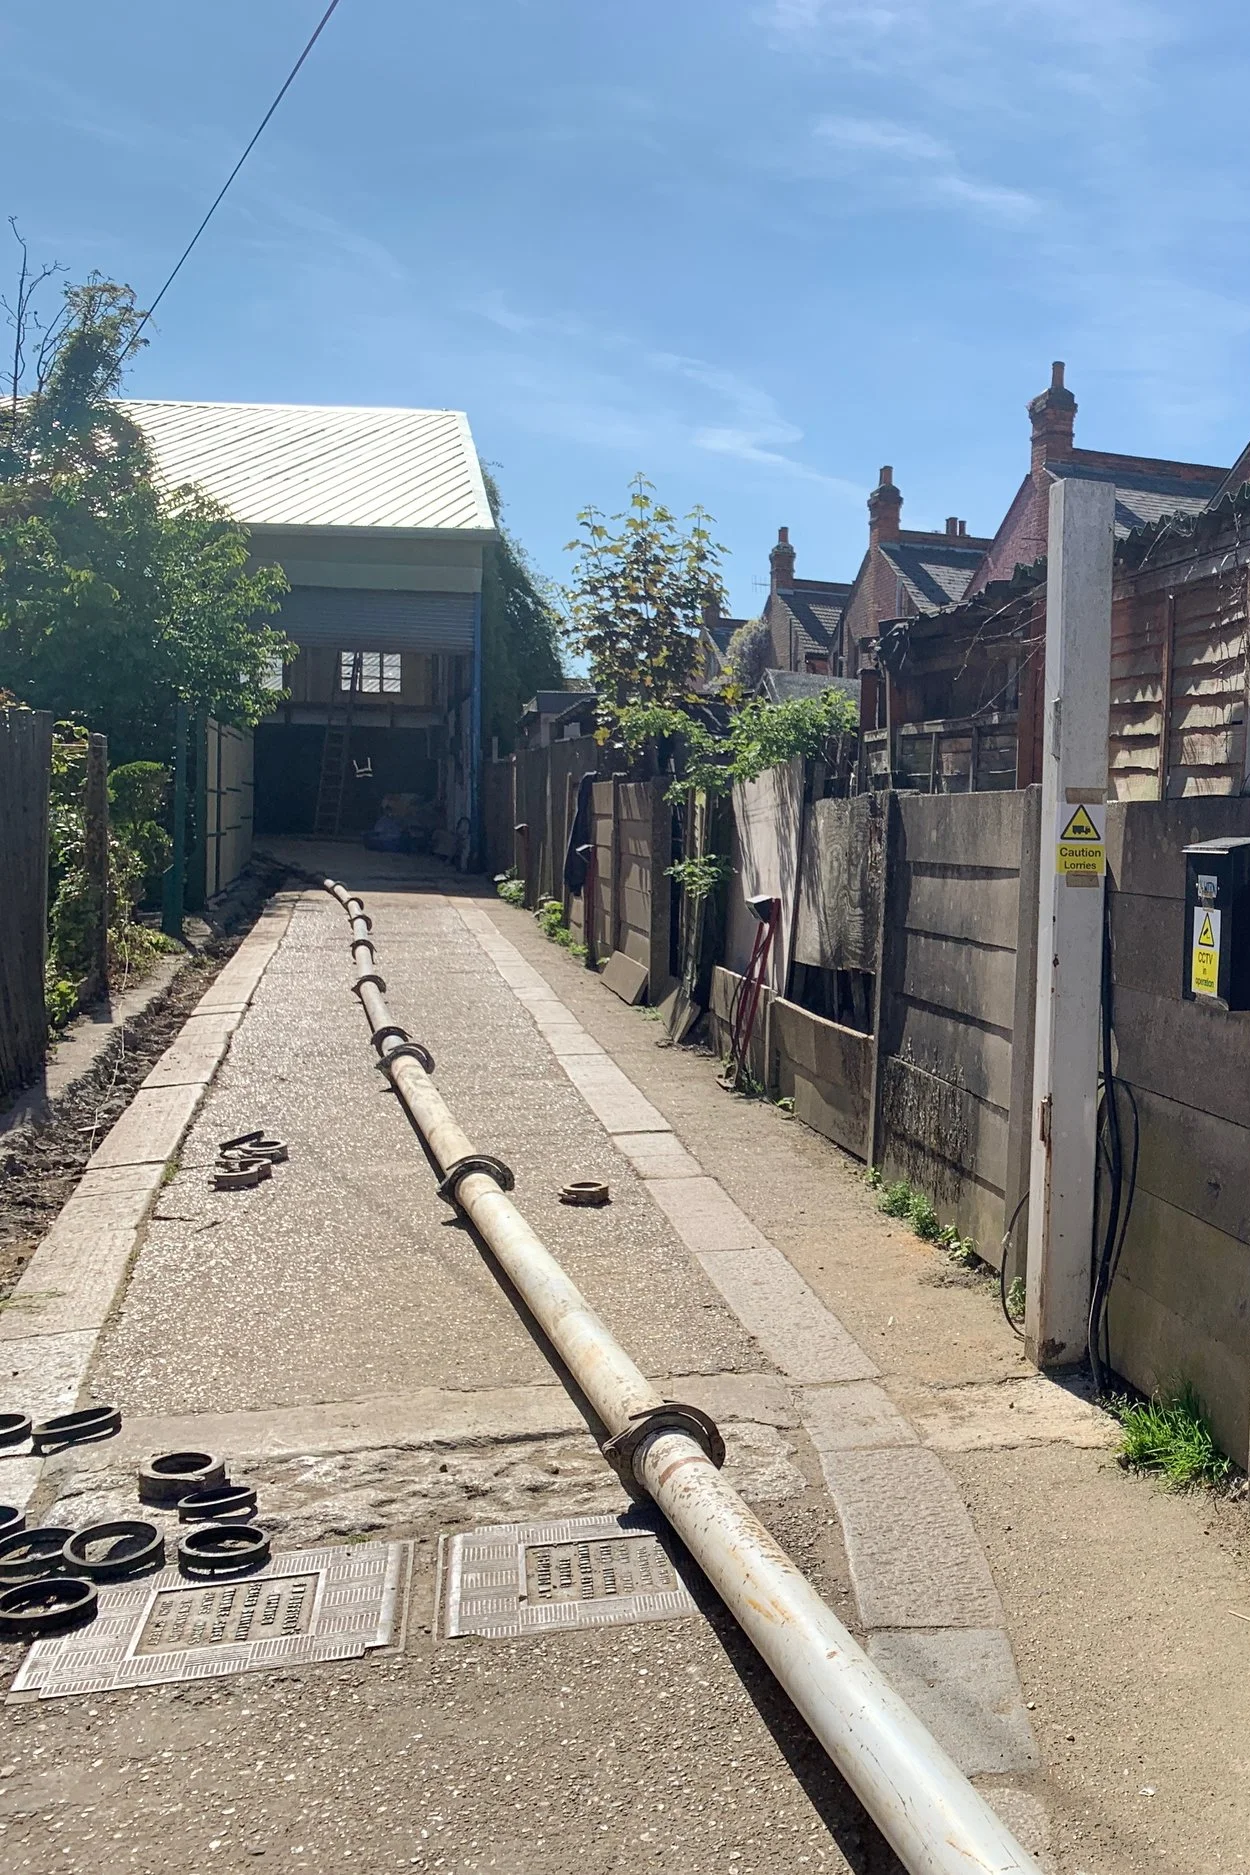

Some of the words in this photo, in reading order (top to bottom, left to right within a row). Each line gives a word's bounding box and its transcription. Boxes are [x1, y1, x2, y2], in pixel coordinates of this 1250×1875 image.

[1059, 846, 1101, 857] Caution
[1064, 860, 1097, 869] Lorries
[1198, 951, 1213, 965] CCTV
